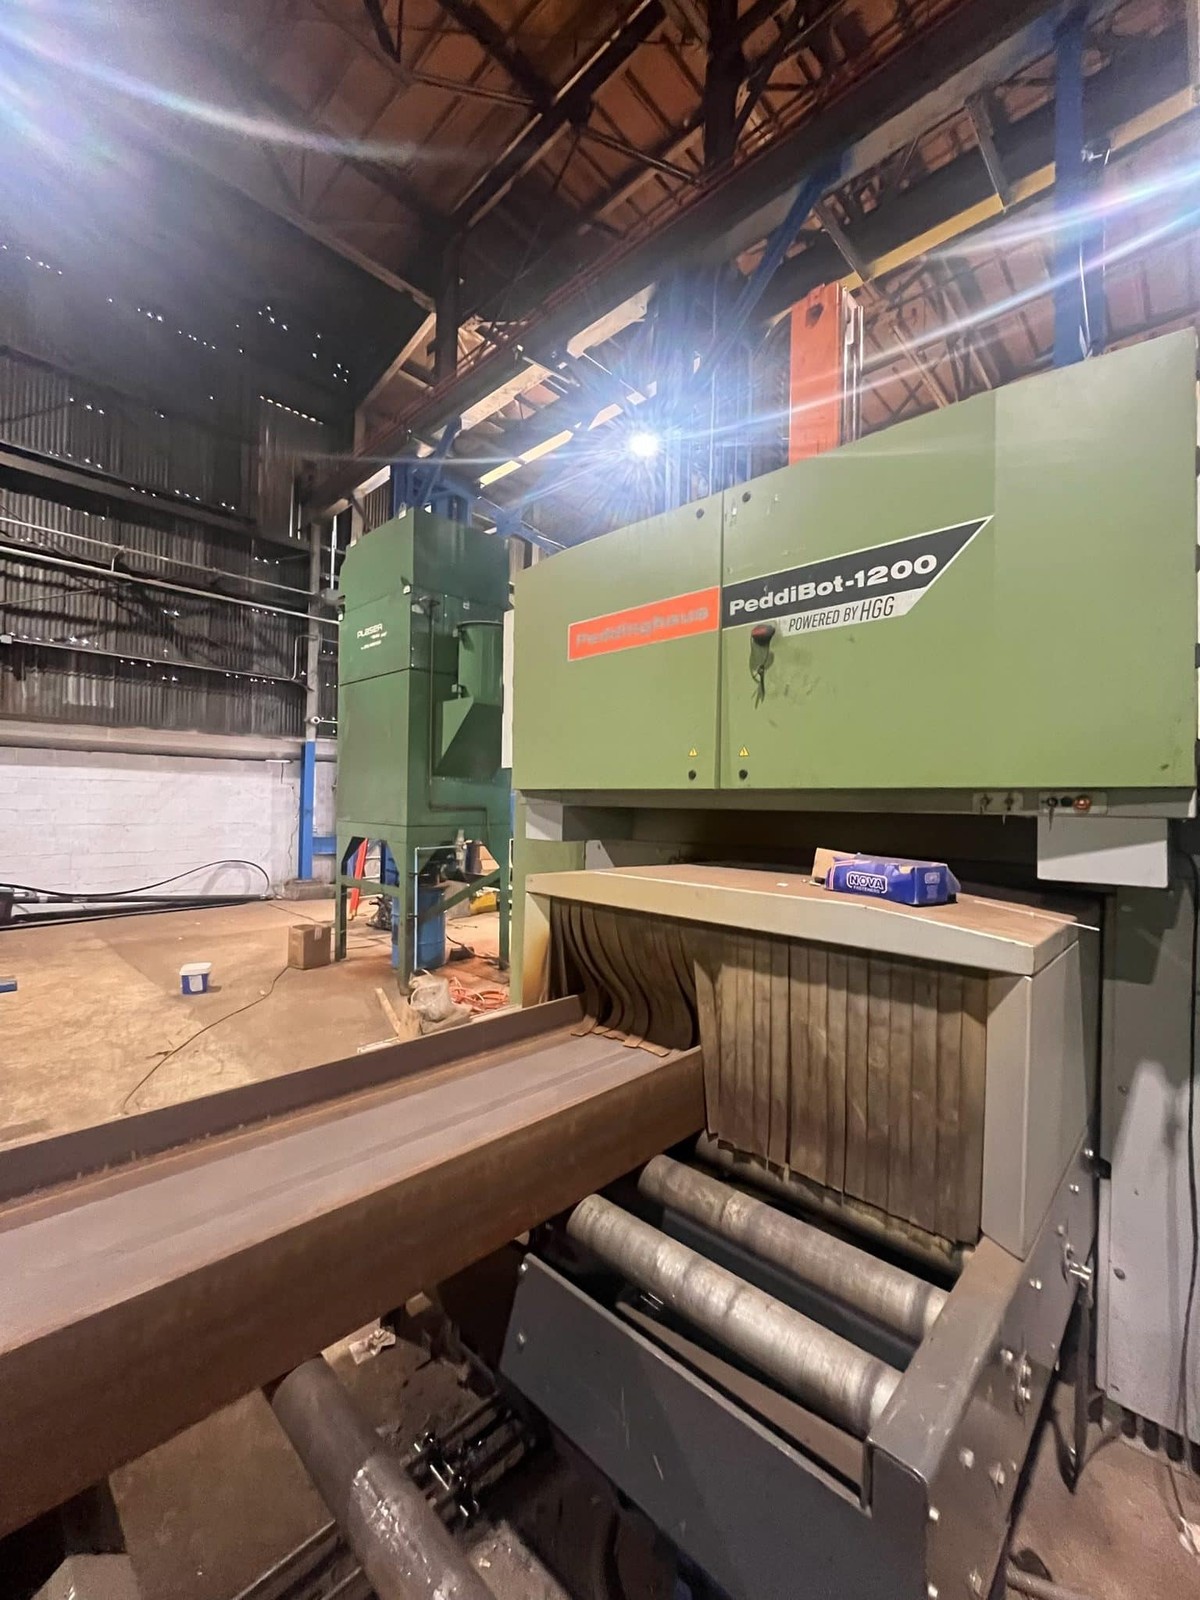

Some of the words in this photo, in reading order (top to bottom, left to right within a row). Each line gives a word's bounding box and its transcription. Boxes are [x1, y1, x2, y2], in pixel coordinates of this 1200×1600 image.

[729, 554, 938, 616] PeddiBot-1200
[788, 609, 840, 632] POWERED
[843, 605, 859, 621] BY
[860, 596, 895, 622] HGG
[849, 874, 884, 890] NOVA
